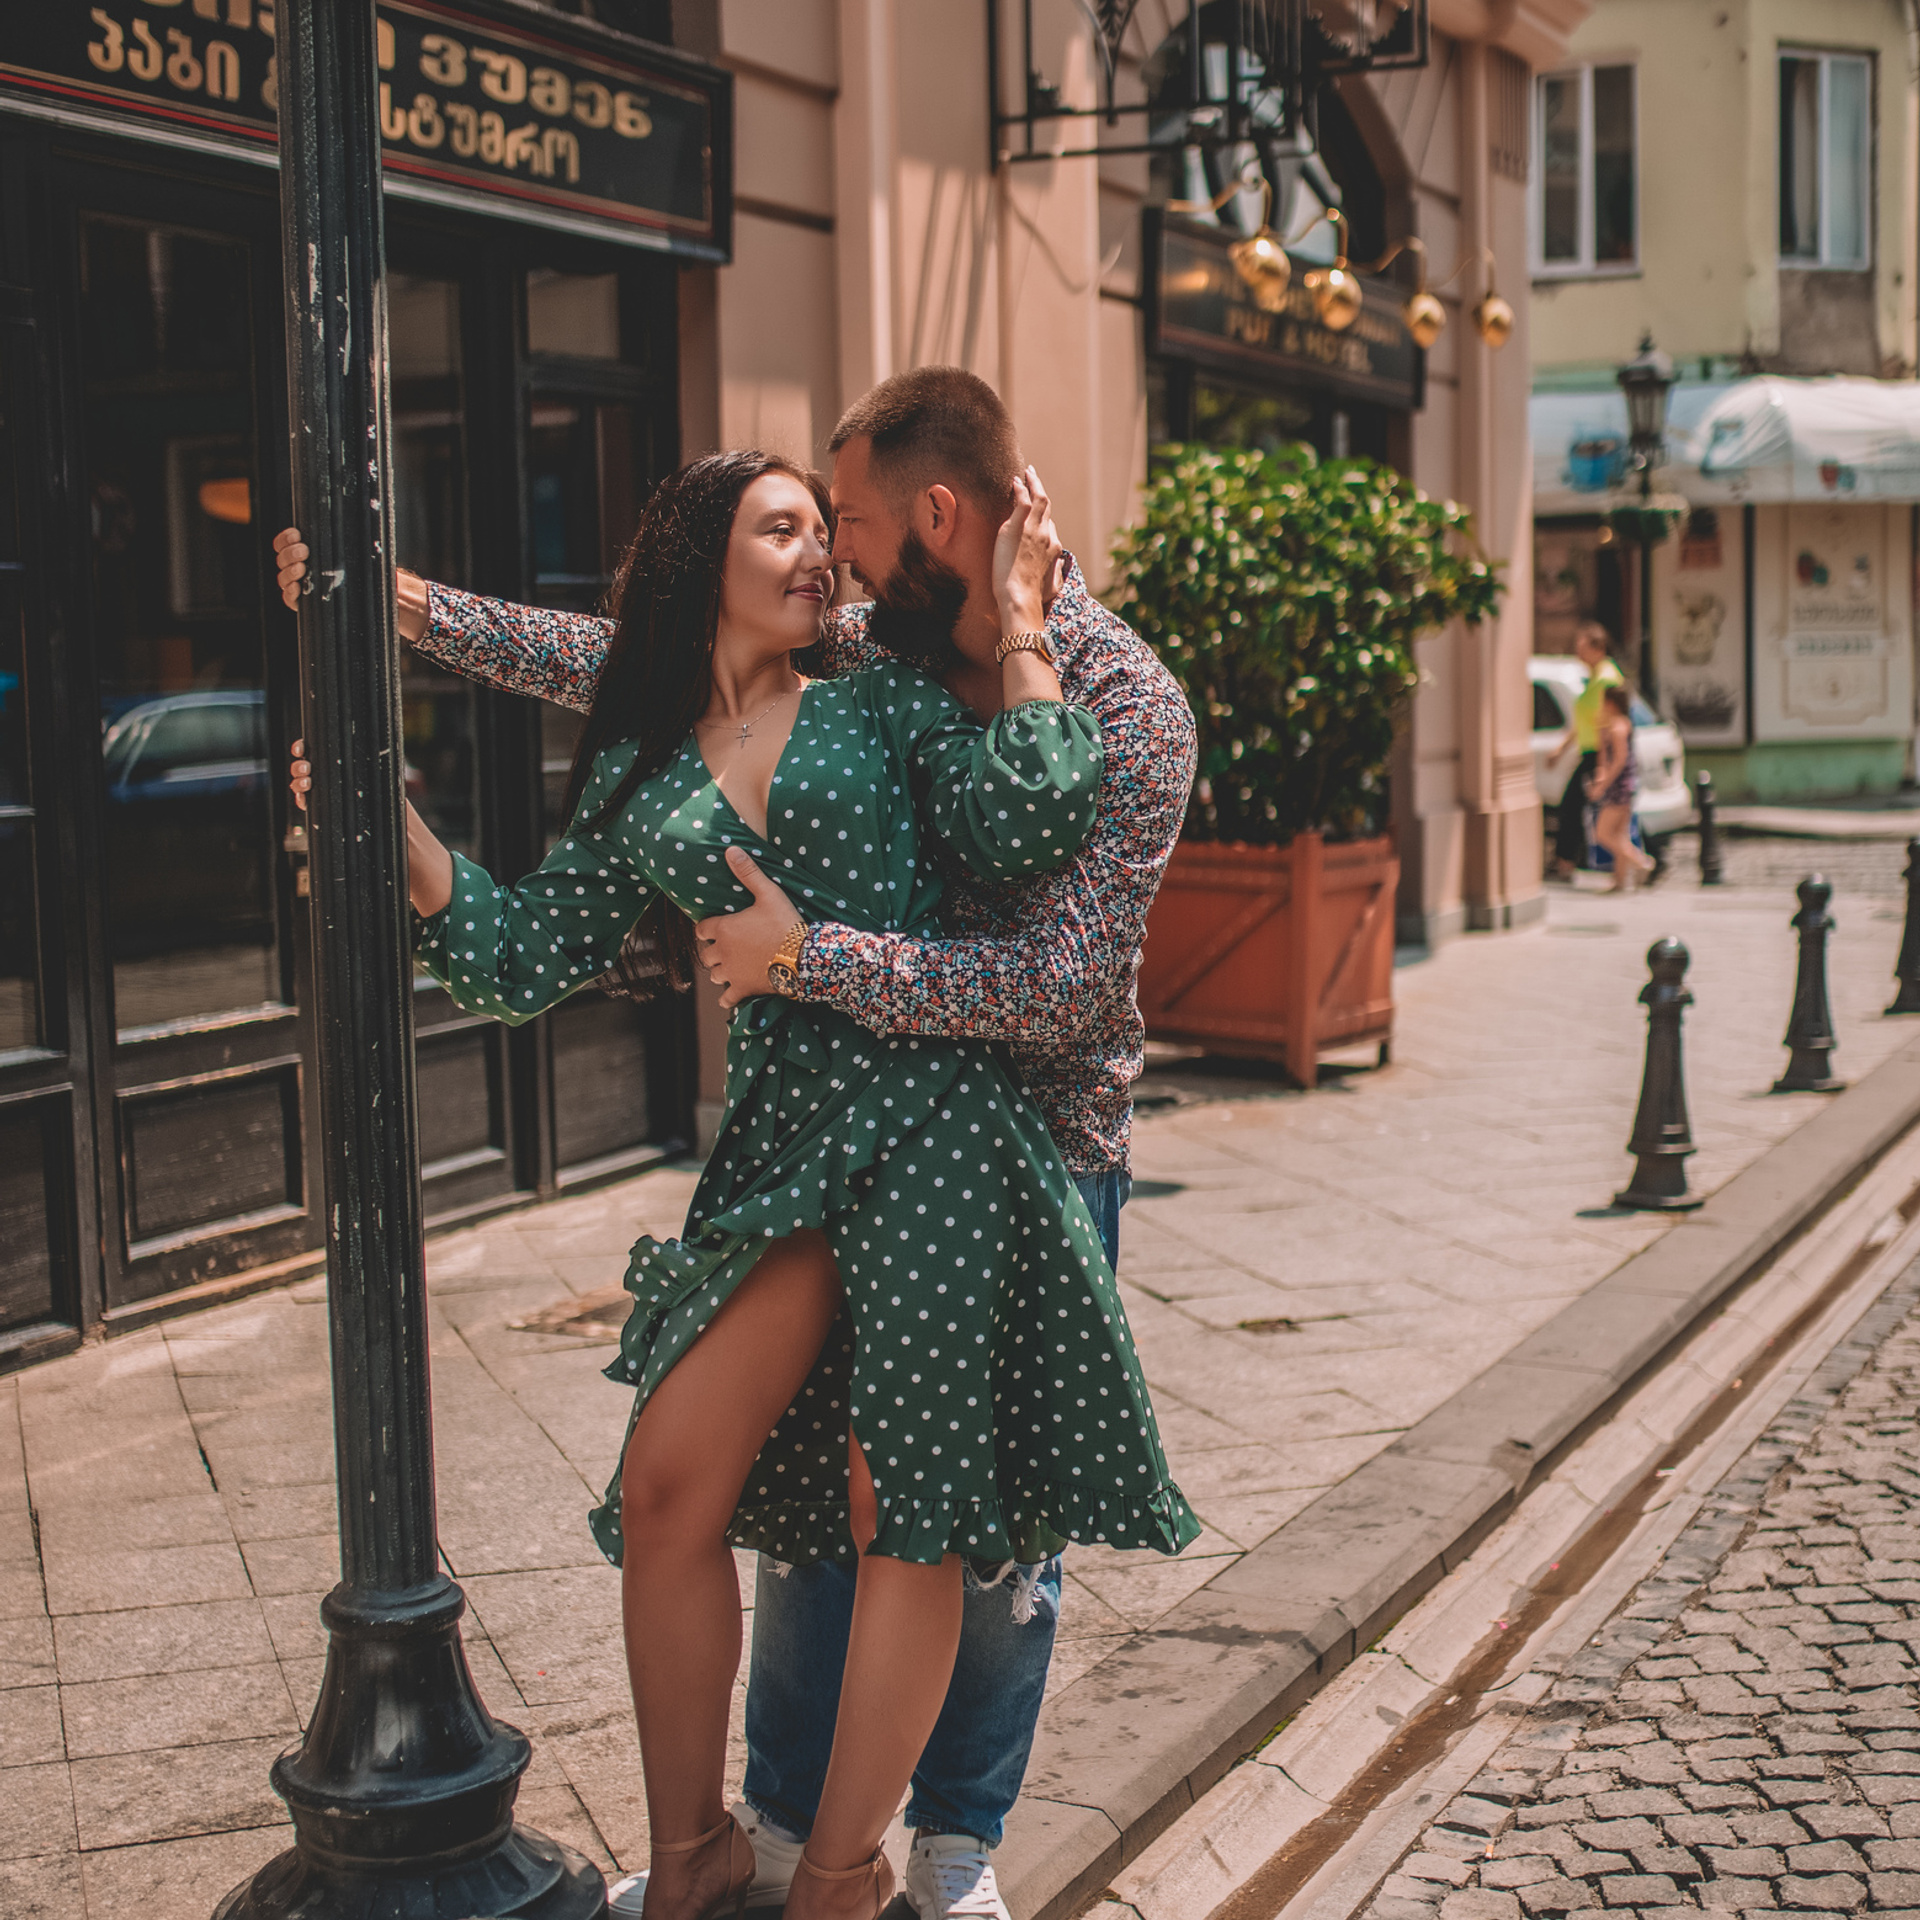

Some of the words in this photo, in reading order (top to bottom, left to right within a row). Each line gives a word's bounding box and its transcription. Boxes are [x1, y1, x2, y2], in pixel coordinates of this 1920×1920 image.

[87, 6, 240, 102] პაბი
[379, 81, 581, 184] სტუმრო
[418, 33, 653, 139] ვუმენ
